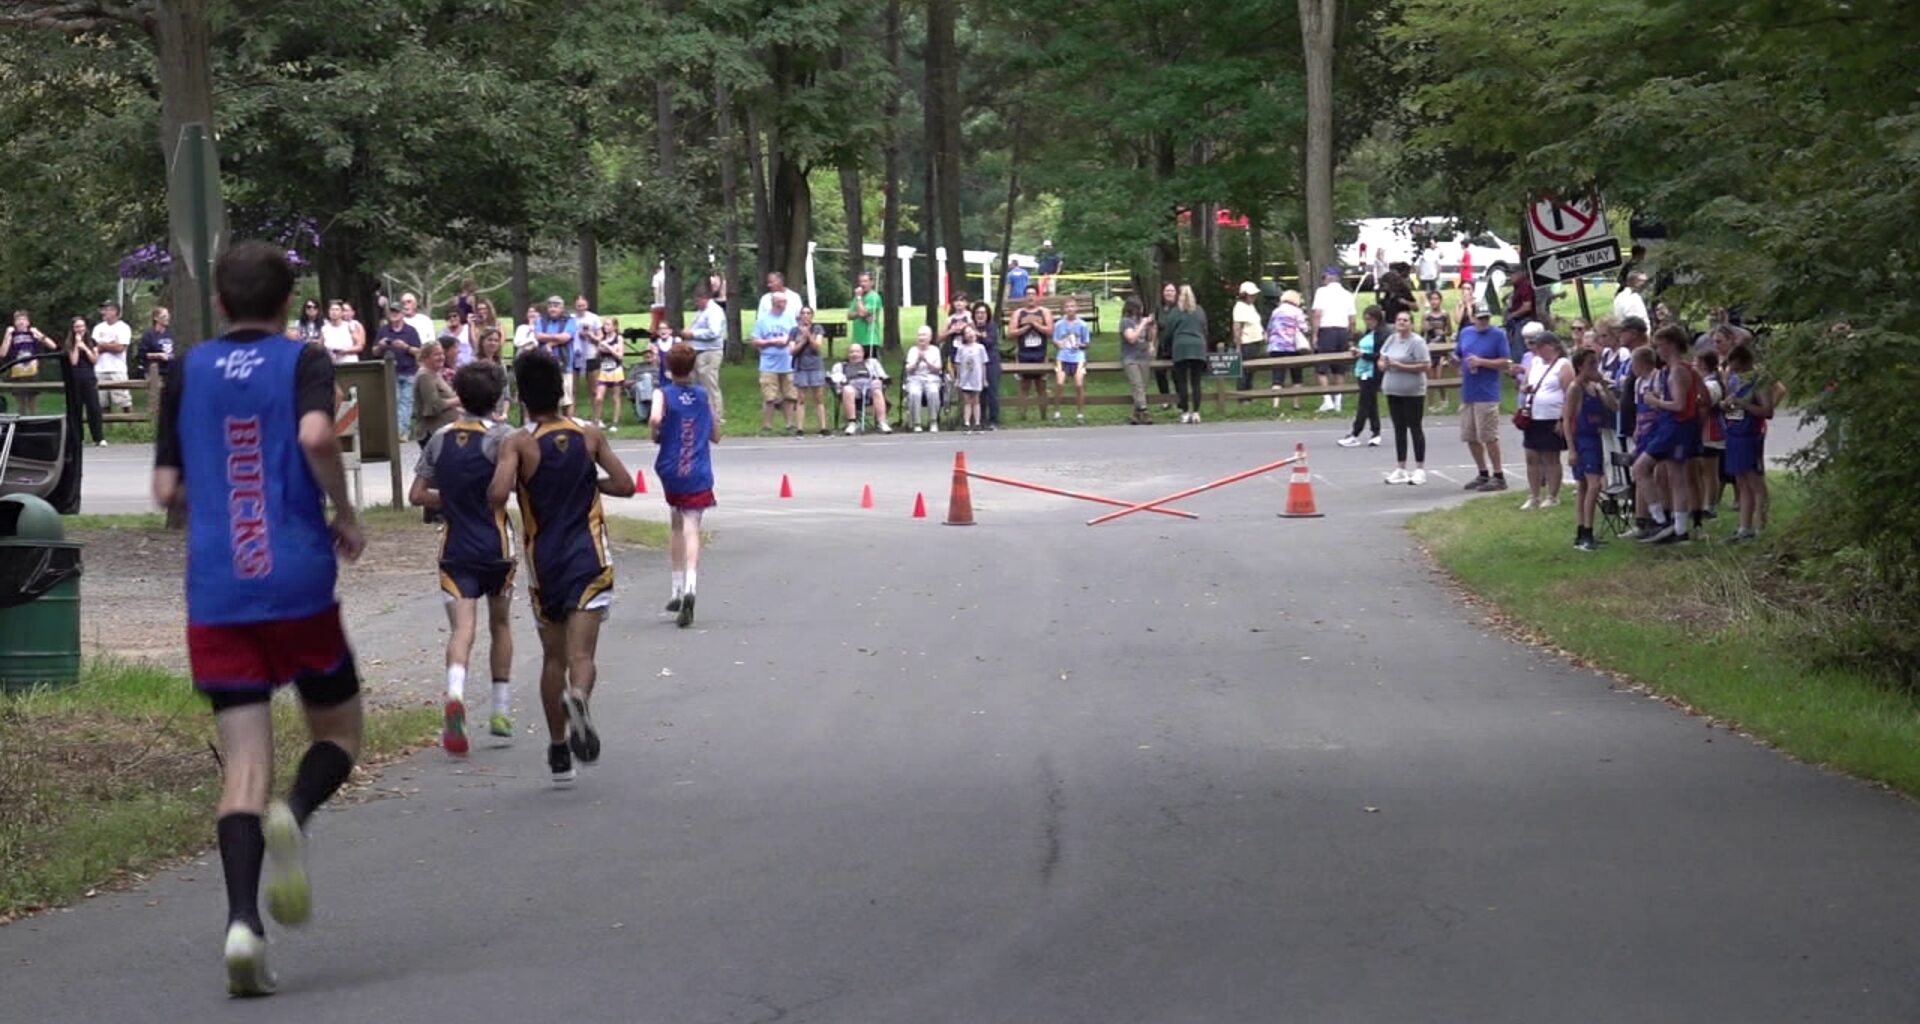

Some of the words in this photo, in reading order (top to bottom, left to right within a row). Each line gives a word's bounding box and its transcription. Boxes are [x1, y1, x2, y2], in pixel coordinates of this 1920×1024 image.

[1558, 256, 1582, 272] ONE
[1585, 248, 1610, 264] WAY
[224, 415, 273, 579] BUCKS
